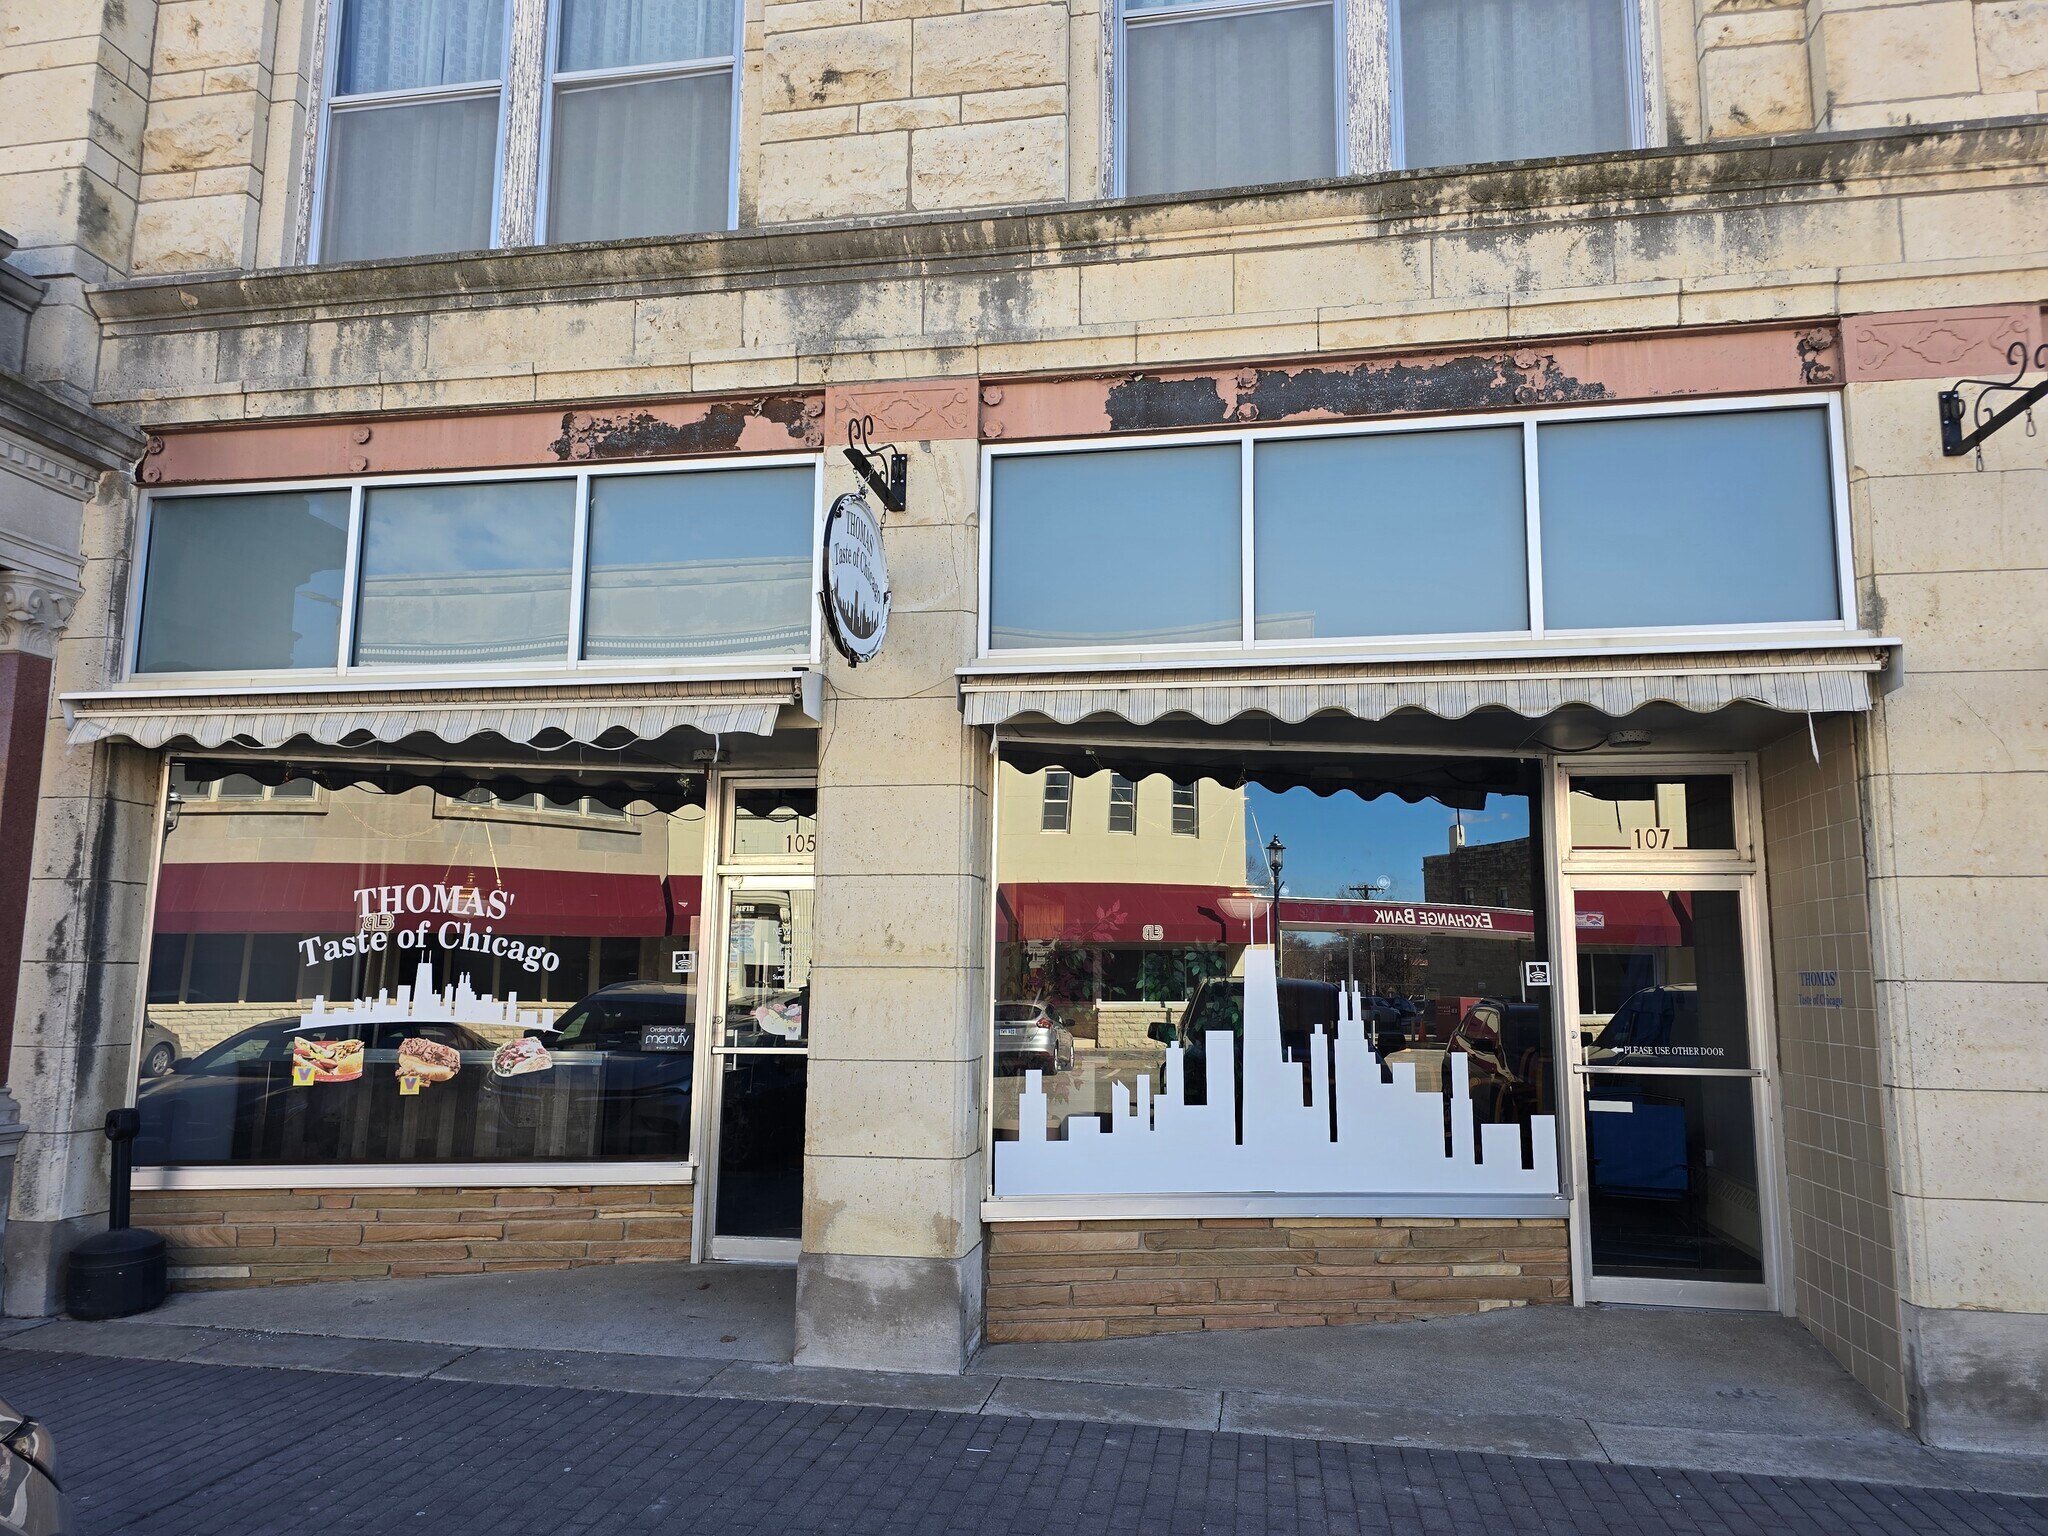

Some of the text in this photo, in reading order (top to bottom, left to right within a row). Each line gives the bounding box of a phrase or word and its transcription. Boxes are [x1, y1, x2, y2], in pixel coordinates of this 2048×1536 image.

[846, 510, 874, 557] THOMAS
[834, 542, 880, 604] Taste of Chicago
[786, 834, 816, 853] 105
[1635, 828, 1670, 849] 107
[353, 883, 516, 920] THOMAS'
[298, 920, 560, 973] Taste of Chicago
[645, 1033, 690, 1047] menufy
[1624, 1046, 1725, 1056] PLEASE USE OTHER DOOR
